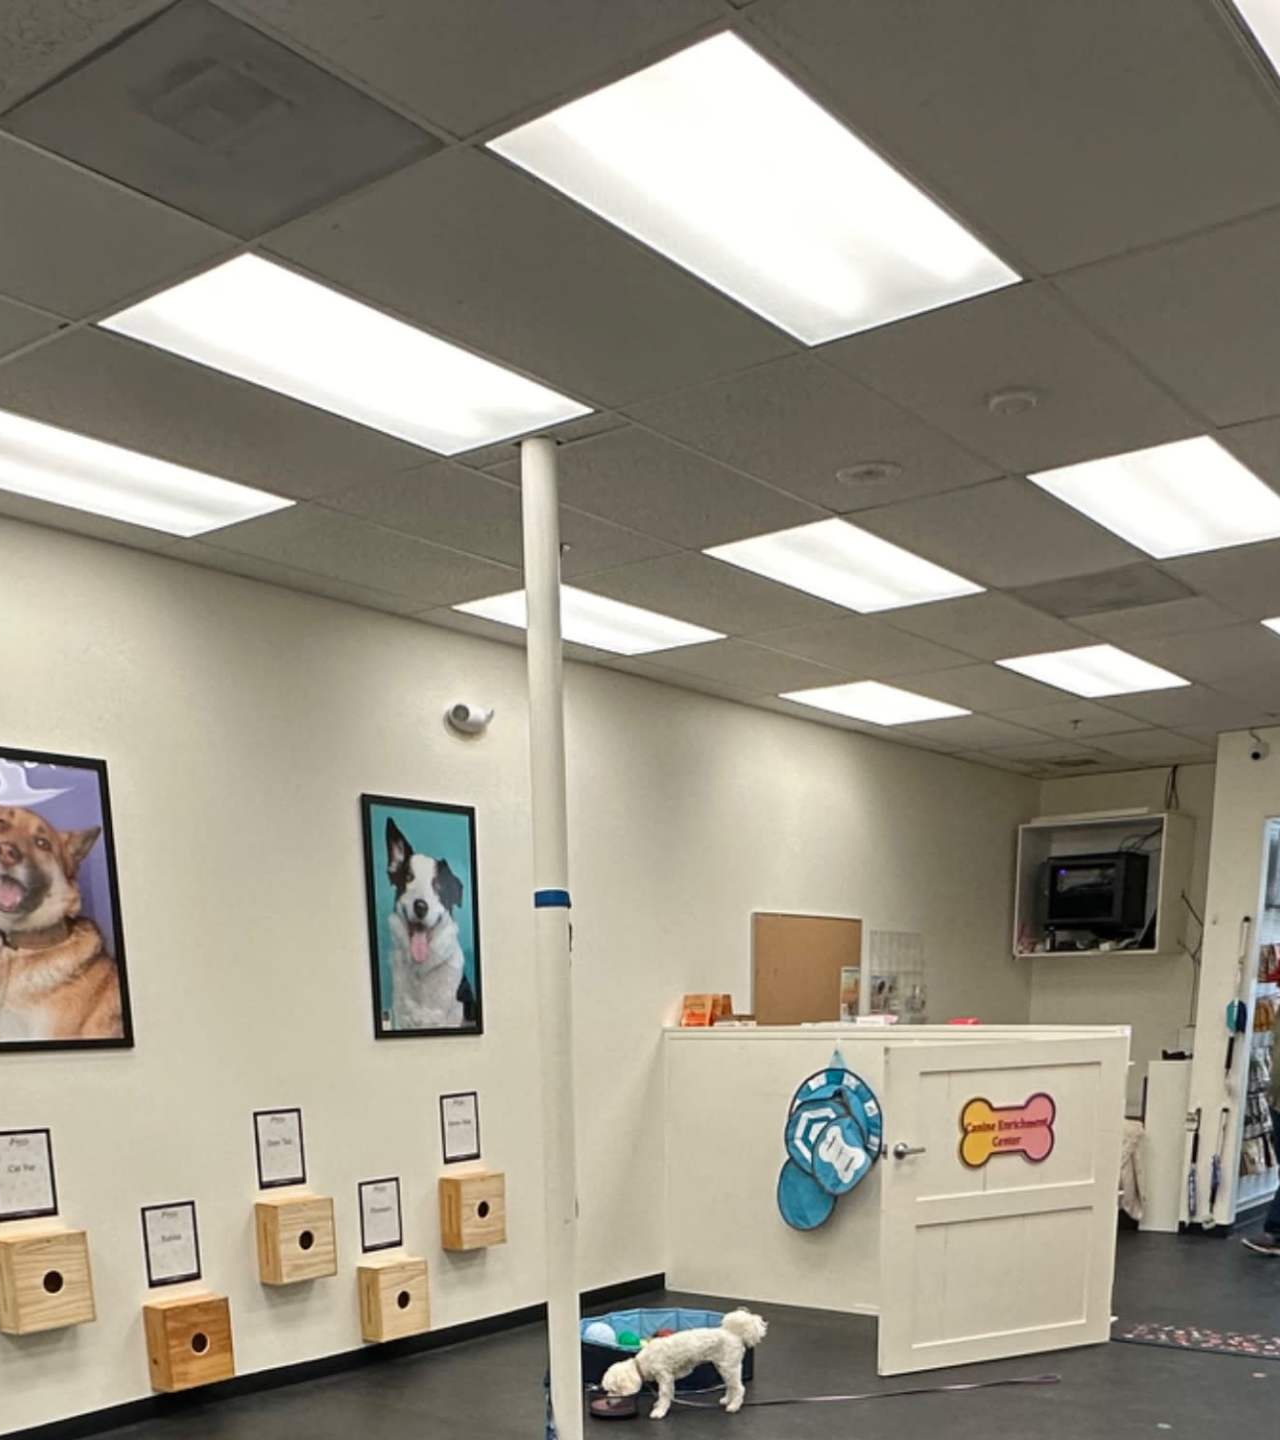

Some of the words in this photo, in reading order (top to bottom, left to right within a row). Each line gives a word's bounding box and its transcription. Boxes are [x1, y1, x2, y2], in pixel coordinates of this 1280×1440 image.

[966, 1122, 996, 1133] Canine
[998, 1118, 1048, 1131] Enrichment
[992, 1135, 1022, 1147] Center
